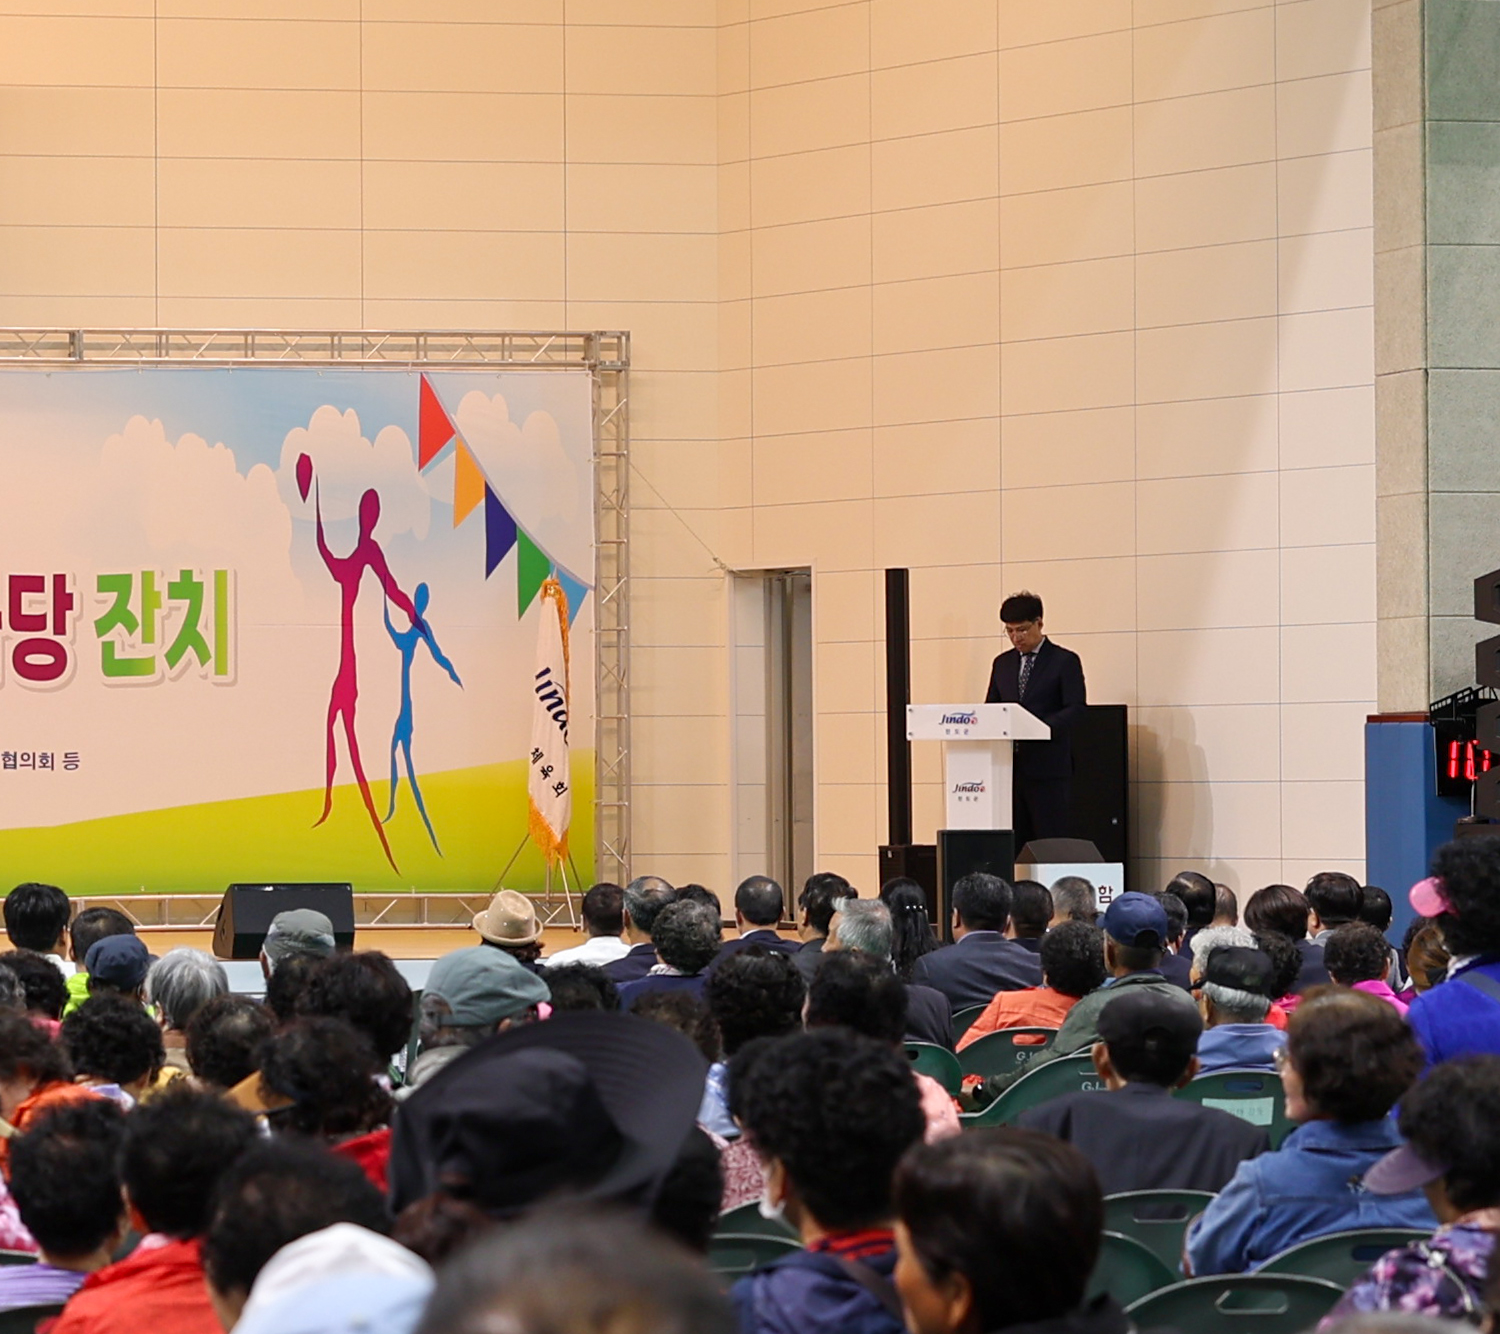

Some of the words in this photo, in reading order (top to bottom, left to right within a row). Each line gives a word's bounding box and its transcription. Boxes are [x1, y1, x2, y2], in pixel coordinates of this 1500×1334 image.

[93, 569, 230, 677] 잔치
[938, 713, 971, 726] Jindo
[62, 751, 81, 772] 등
[529, 746, 569, 789] 체육회
[952, 782, 979, 794] Jindo
[1098, 885, 1114, 904] 함
